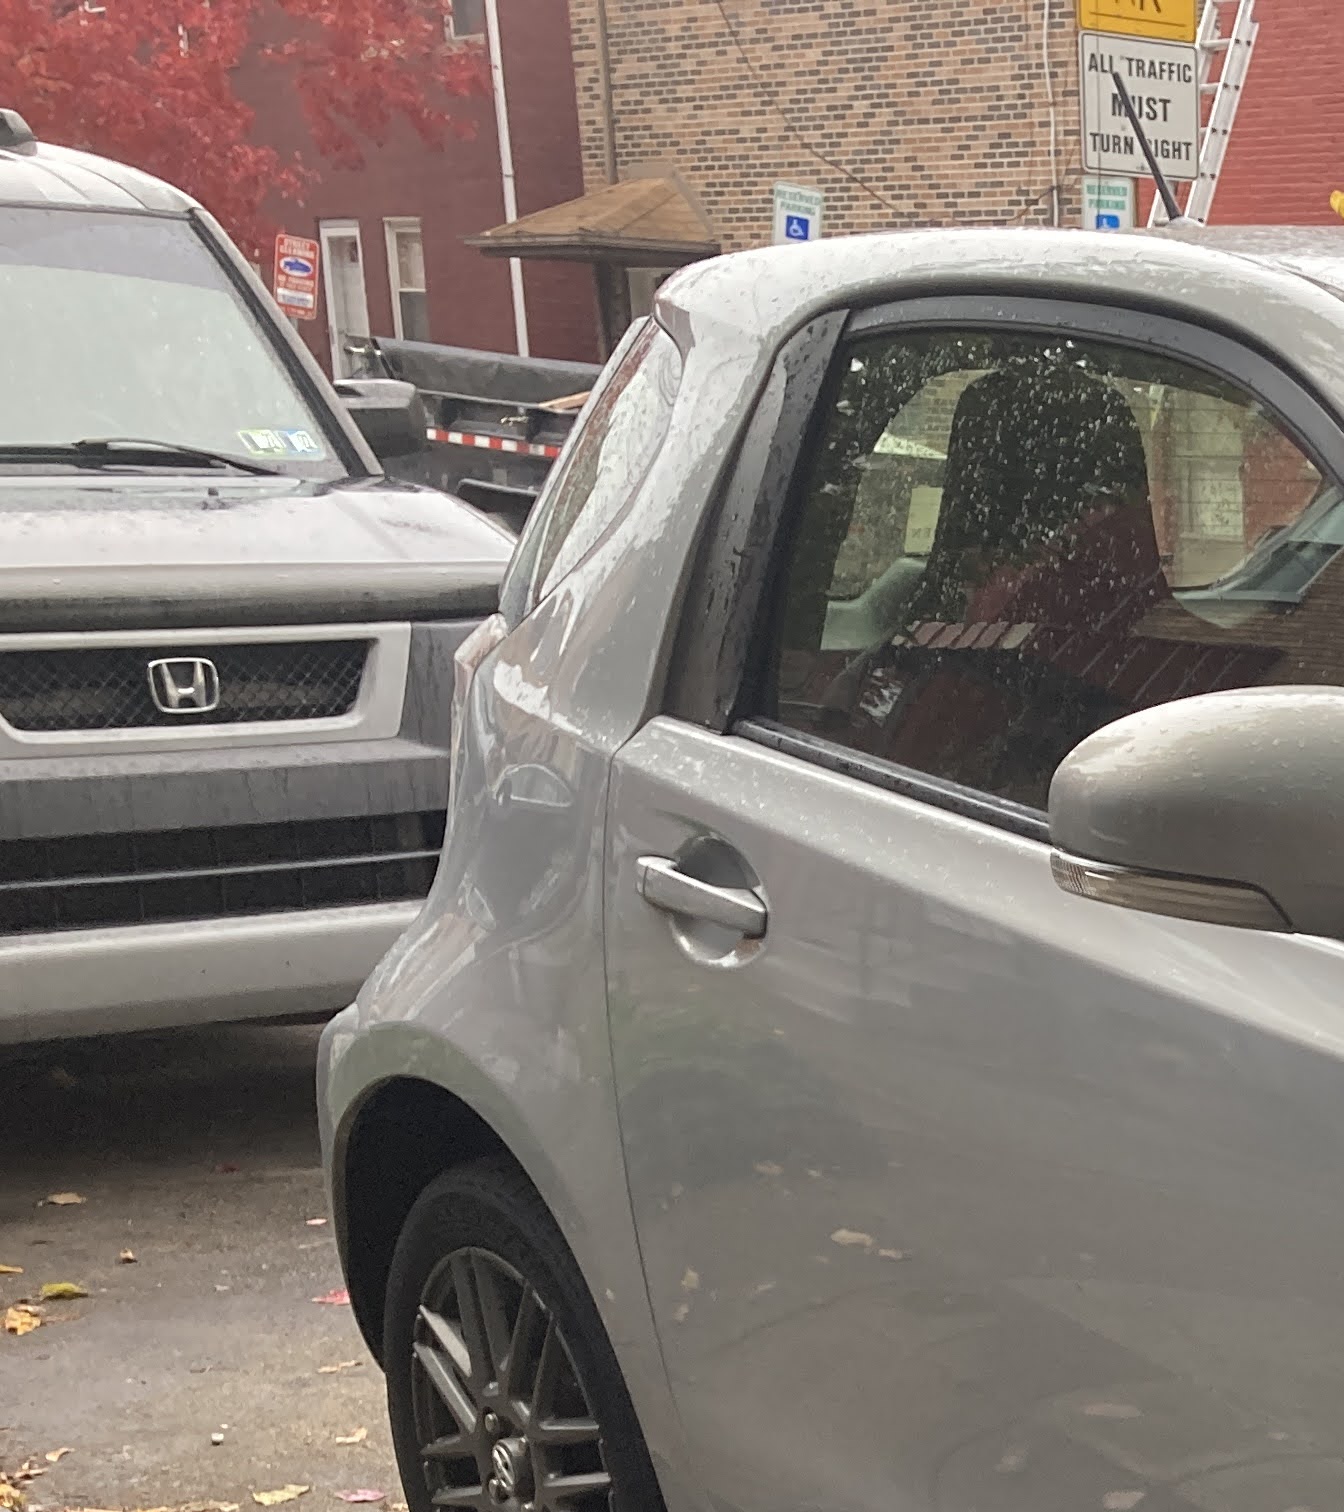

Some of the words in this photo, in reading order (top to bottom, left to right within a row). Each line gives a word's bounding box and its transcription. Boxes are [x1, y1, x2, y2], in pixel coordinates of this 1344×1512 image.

[1088, 53, 1116, 75] ALL
[1126, 57, 1193, 83] TRAFFIC
[1111, 92, 1172, 122] MUST
[1089, 132, 1135, 155] TURN
